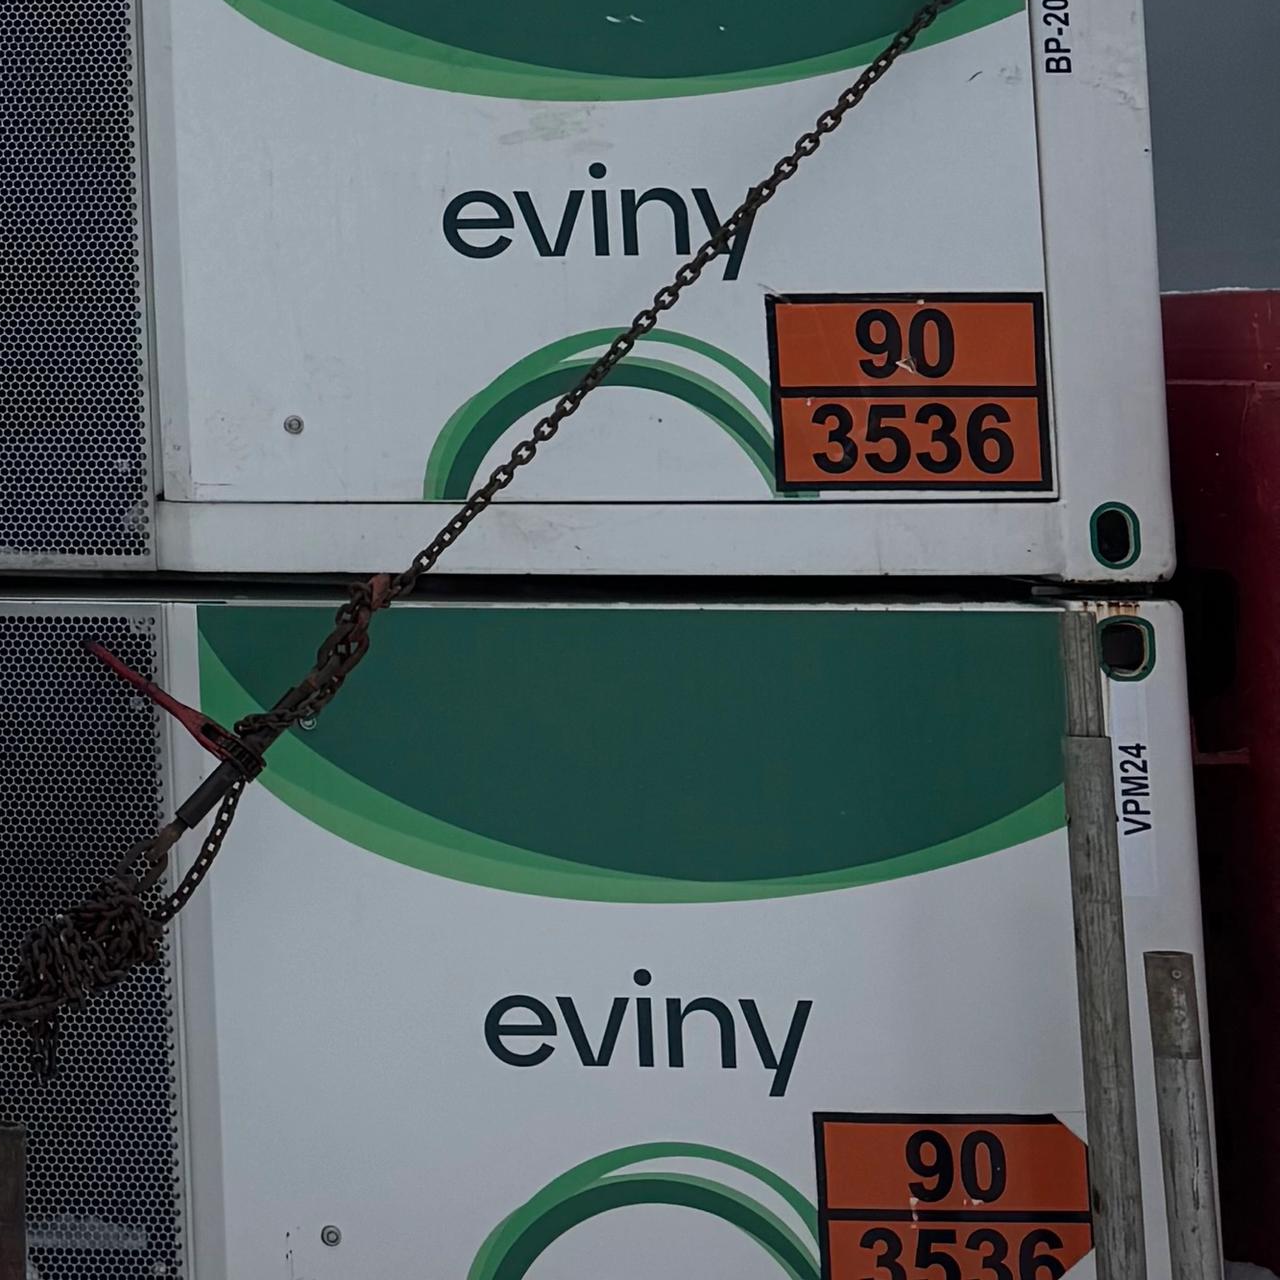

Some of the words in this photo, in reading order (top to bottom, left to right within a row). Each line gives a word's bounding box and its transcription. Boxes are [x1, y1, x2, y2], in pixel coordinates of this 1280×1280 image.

[443, 162, 758, 281] eviny
[856, 309, 954, 379] 90
[812, 403, 1014, 475] 3536
[1118, 743, 1151, 836] VPM24
[485, 969, 812, 1097] eviny
[905, 1130, 1007, 1203] 90
